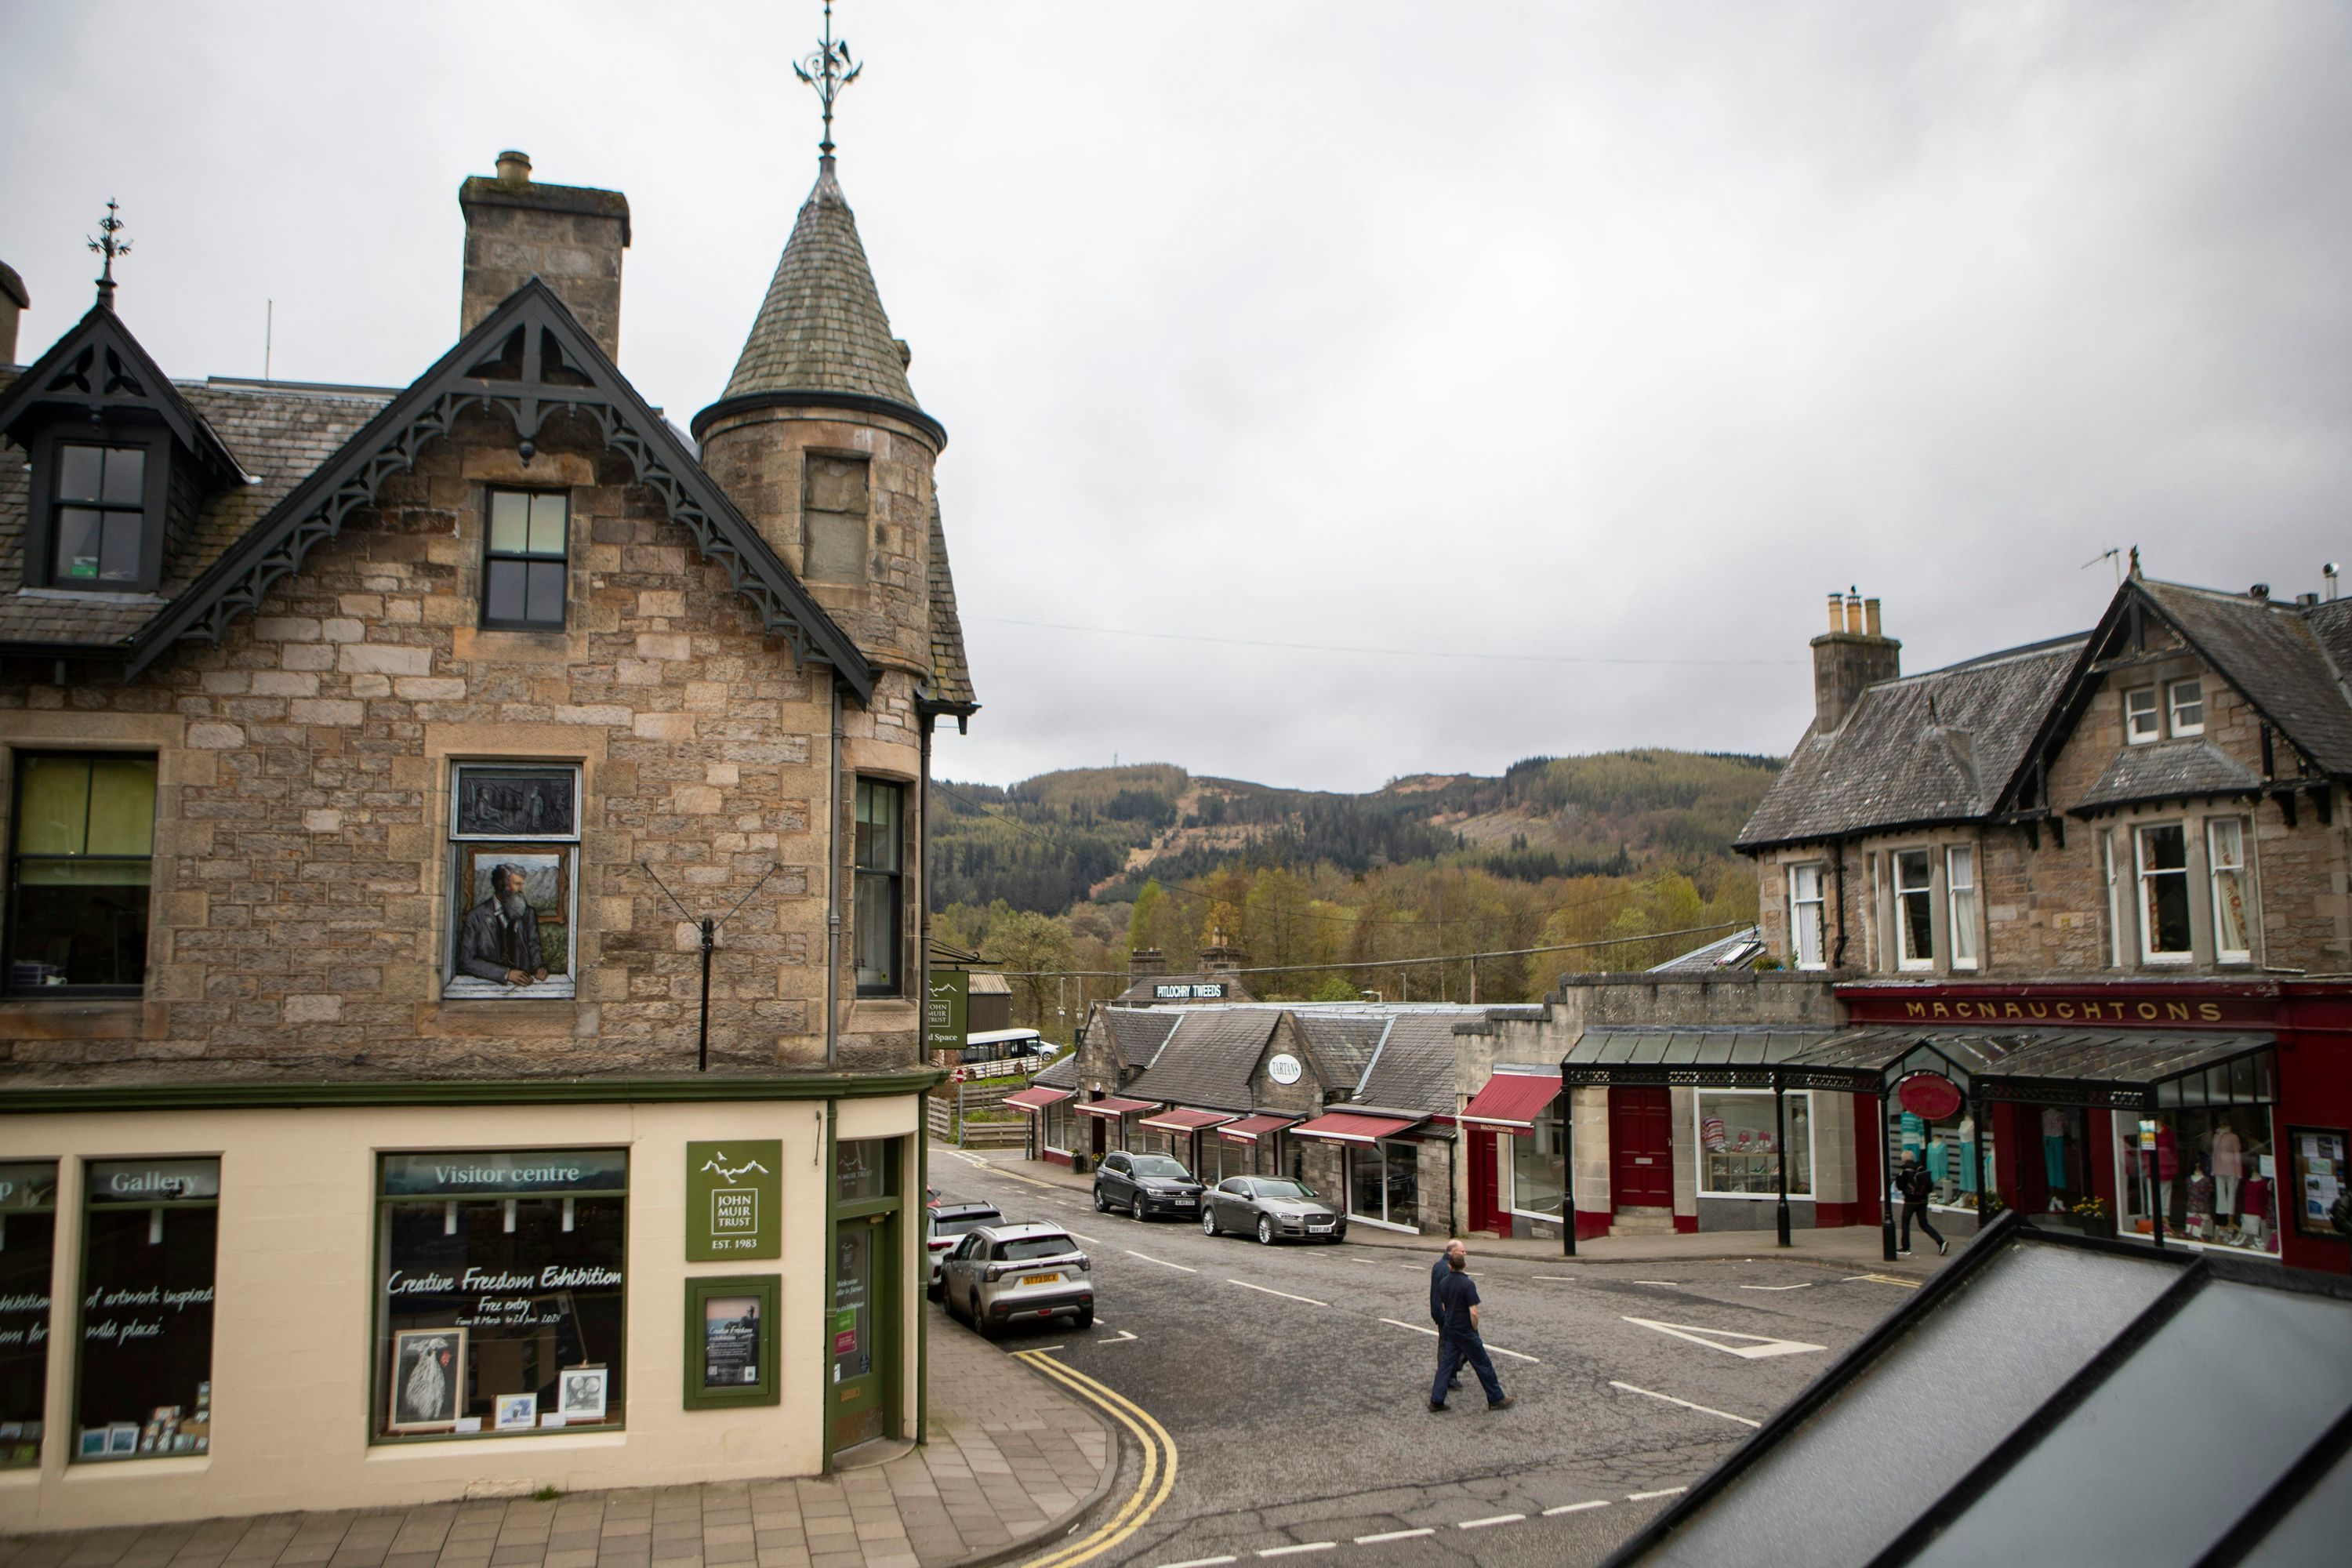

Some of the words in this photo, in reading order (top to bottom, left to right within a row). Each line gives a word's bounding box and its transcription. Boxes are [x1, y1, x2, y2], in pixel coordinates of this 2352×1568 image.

[1157, 985, 1191, 998] PITLOCHRY
[1192, 984, 1221, 997] TWEEDS
[1905, 1001, 2221, 1022] MACNAUGHTONS
[935, 1033, 958, 1043] Space
[1272, 1062, 1299, 1076] TARTANS
[435, 1165, 506, 1184] Visitor
[510, 1166, 580, 1182] centre
[111, 1171, 198, 1197] Gallery
[717, 1196, 752, 1208] JOHN
[717, 1207, 752, 1218] MUIR
[717, 1218, 752, 1228] TRUST
[712, 1240, 732, 1250] EST.
[735, 1239, 758, 1249] 1983
[387, 1270, 456, 1294] Creative
[461, 1267, 535, 1291] Freedom
[540, 1265, 622, 1288] Exhibition
[85, 1287, 103, 1308] of
[104, 1285, 159, 1307] artwork
[162, 1286, 214, 1313] inspired
[478, 1295, 503, 1312] Free
[504, 1297, 532, 1317] entry
[481, 1316, 502, 1325] March
[541, 1313, 562, 1324] 2024
